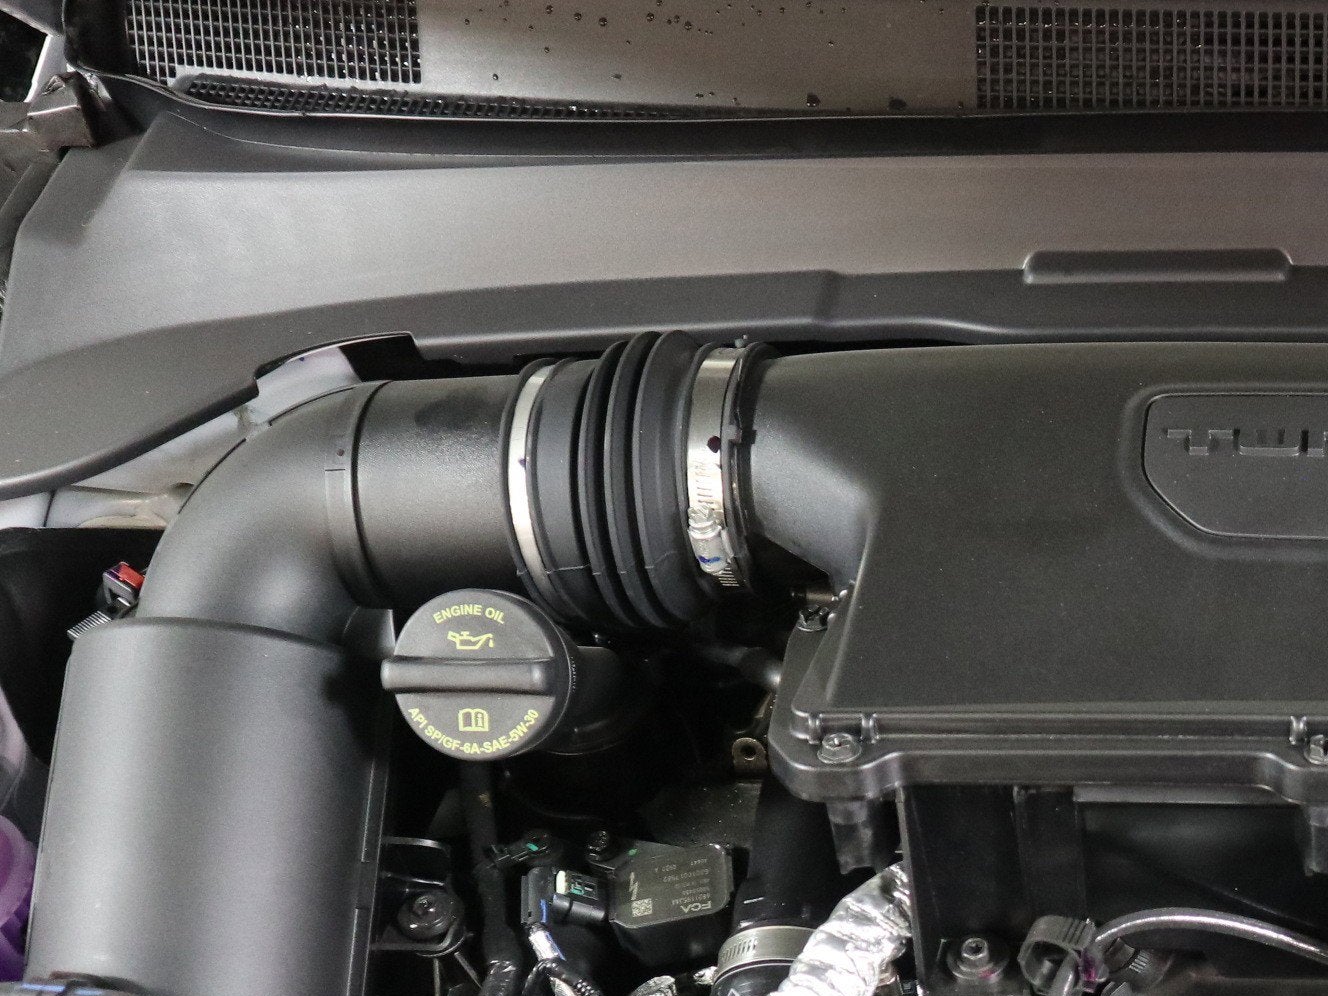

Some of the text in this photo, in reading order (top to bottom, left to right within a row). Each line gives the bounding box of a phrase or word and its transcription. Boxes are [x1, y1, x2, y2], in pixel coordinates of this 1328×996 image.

[432, 604, 506, 625] ENGINE OIL
[408, 707, 425, 729] API
